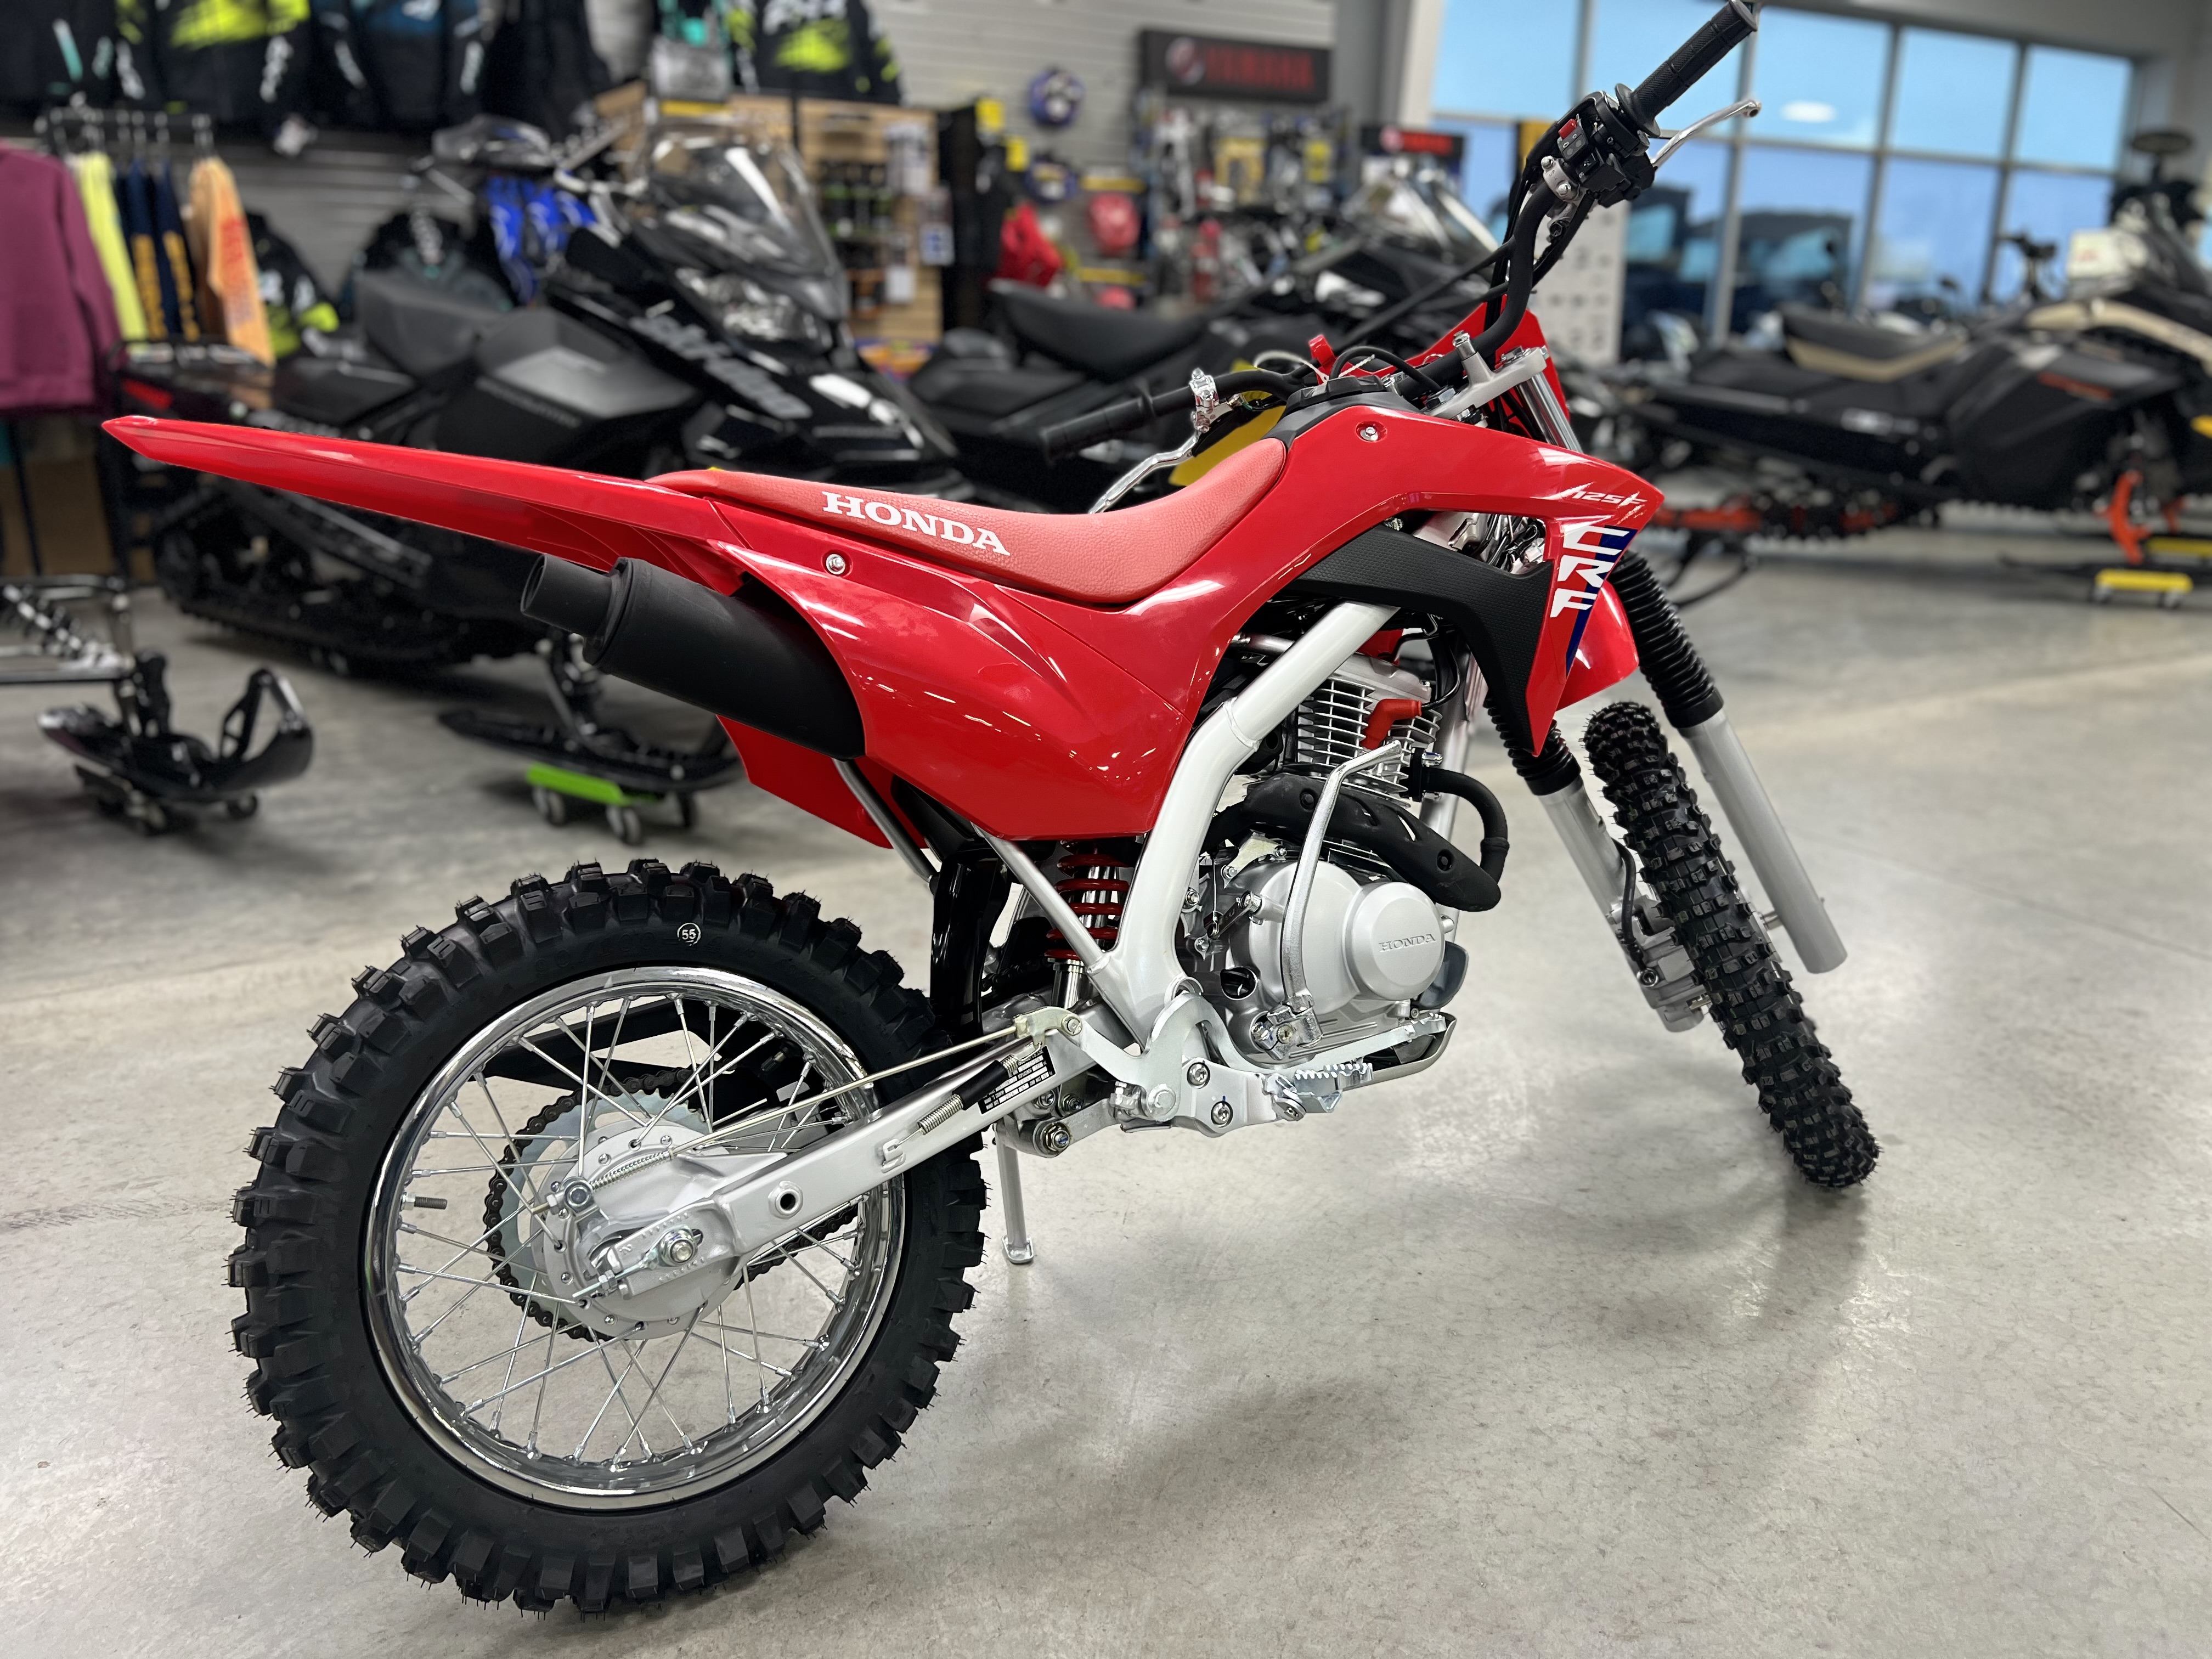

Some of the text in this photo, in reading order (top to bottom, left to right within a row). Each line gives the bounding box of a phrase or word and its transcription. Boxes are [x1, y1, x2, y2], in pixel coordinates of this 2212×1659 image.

[822, 491, 1011, 556] HONDA
[1550, 525, 1629, 618] CRF
[681, 928, 697, 940] 55
[1378, 933, 1437, 952] HONDA
